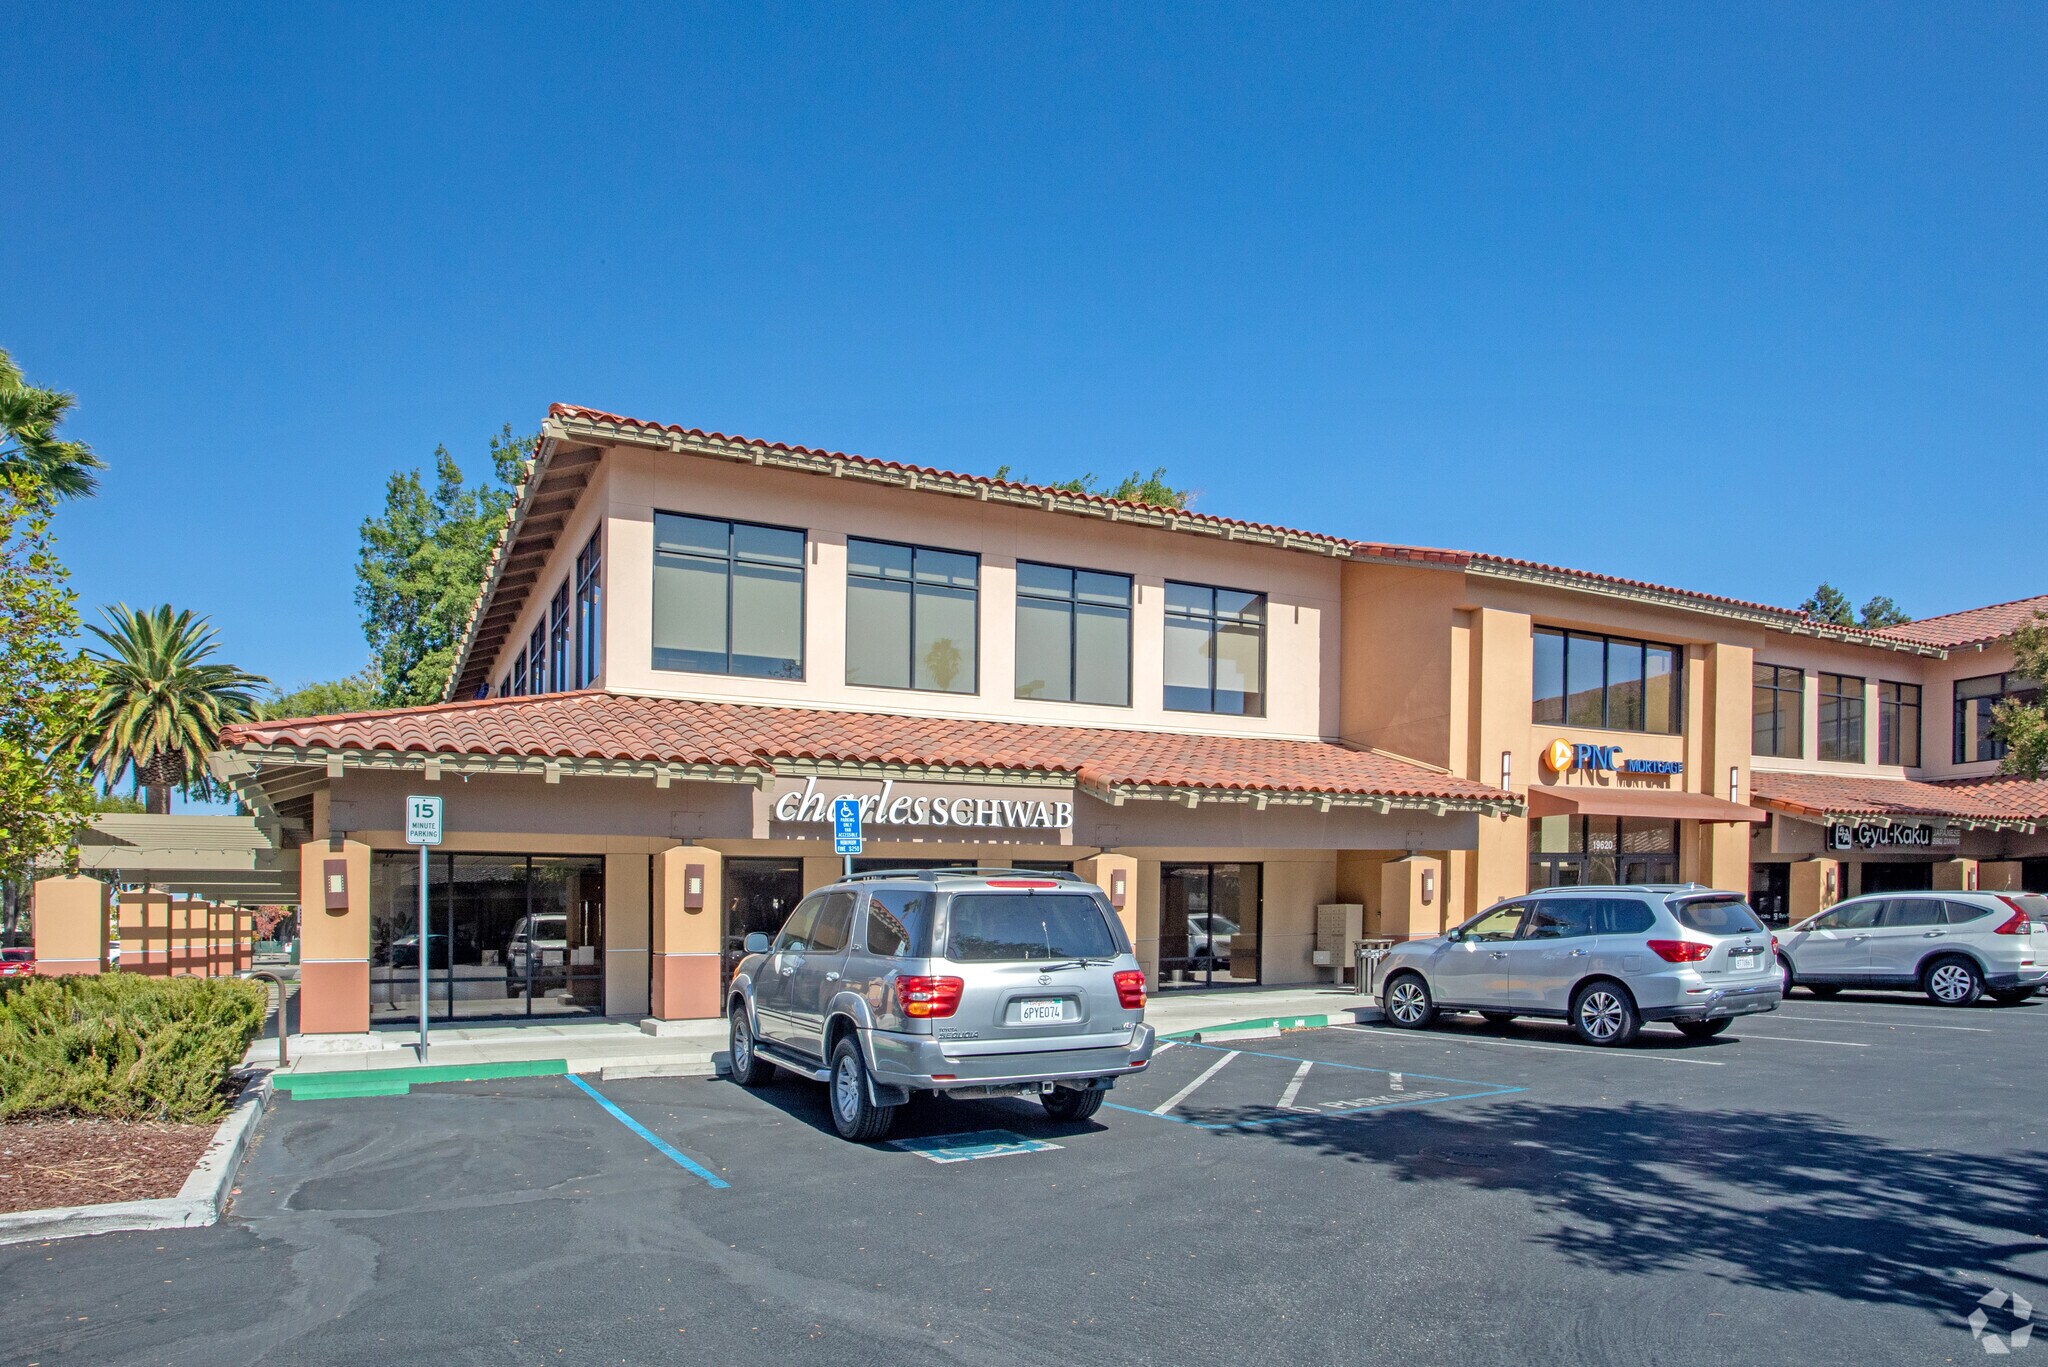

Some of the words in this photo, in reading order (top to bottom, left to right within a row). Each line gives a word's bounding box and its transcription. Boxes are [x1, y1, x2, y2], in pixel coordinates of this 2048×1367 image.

[1575, 743, 1623, 771] PNC
[1629, 759, 1684, 774] MORTGAGE
[414, 804, 434, 818] 15
[931, 797, 1074, 828] SCHWAB
[1859, 823, 1929, 848] Gyu-Kaku
[1932, 829, 1961, 837] JAPANESE
[1593, 840, 1613, 850] 19620
[1023, 1006, 1060, 1019] 6PYE074
[938, 1031, 979, 1039] SEQUOIA
